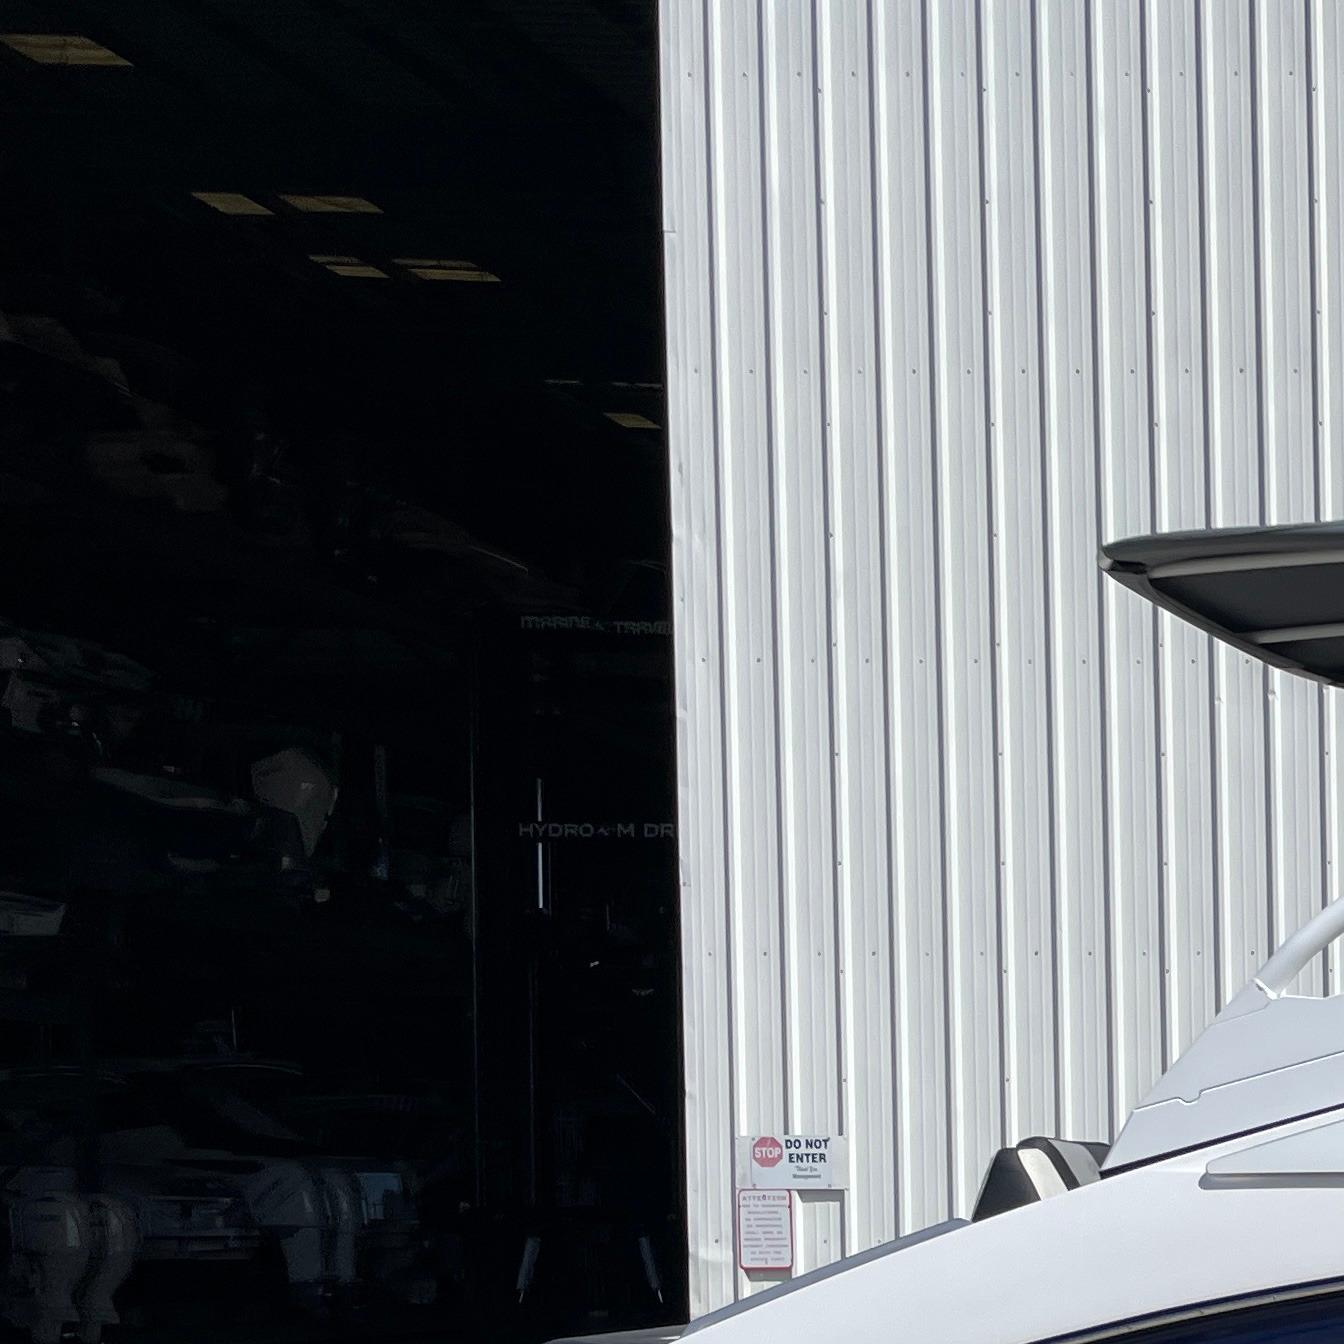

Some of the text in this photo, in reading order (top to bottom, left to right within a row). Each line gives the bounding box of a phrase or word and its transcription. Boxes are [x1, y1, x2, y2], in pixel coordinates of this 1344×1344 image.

[518, 822, 594, 838] HYDRO
[785, 1138, 829, 1150] DO NOT
[754, 1147, 782, 1159] STOP
[788, 1152, 827, 1163] ENTER
